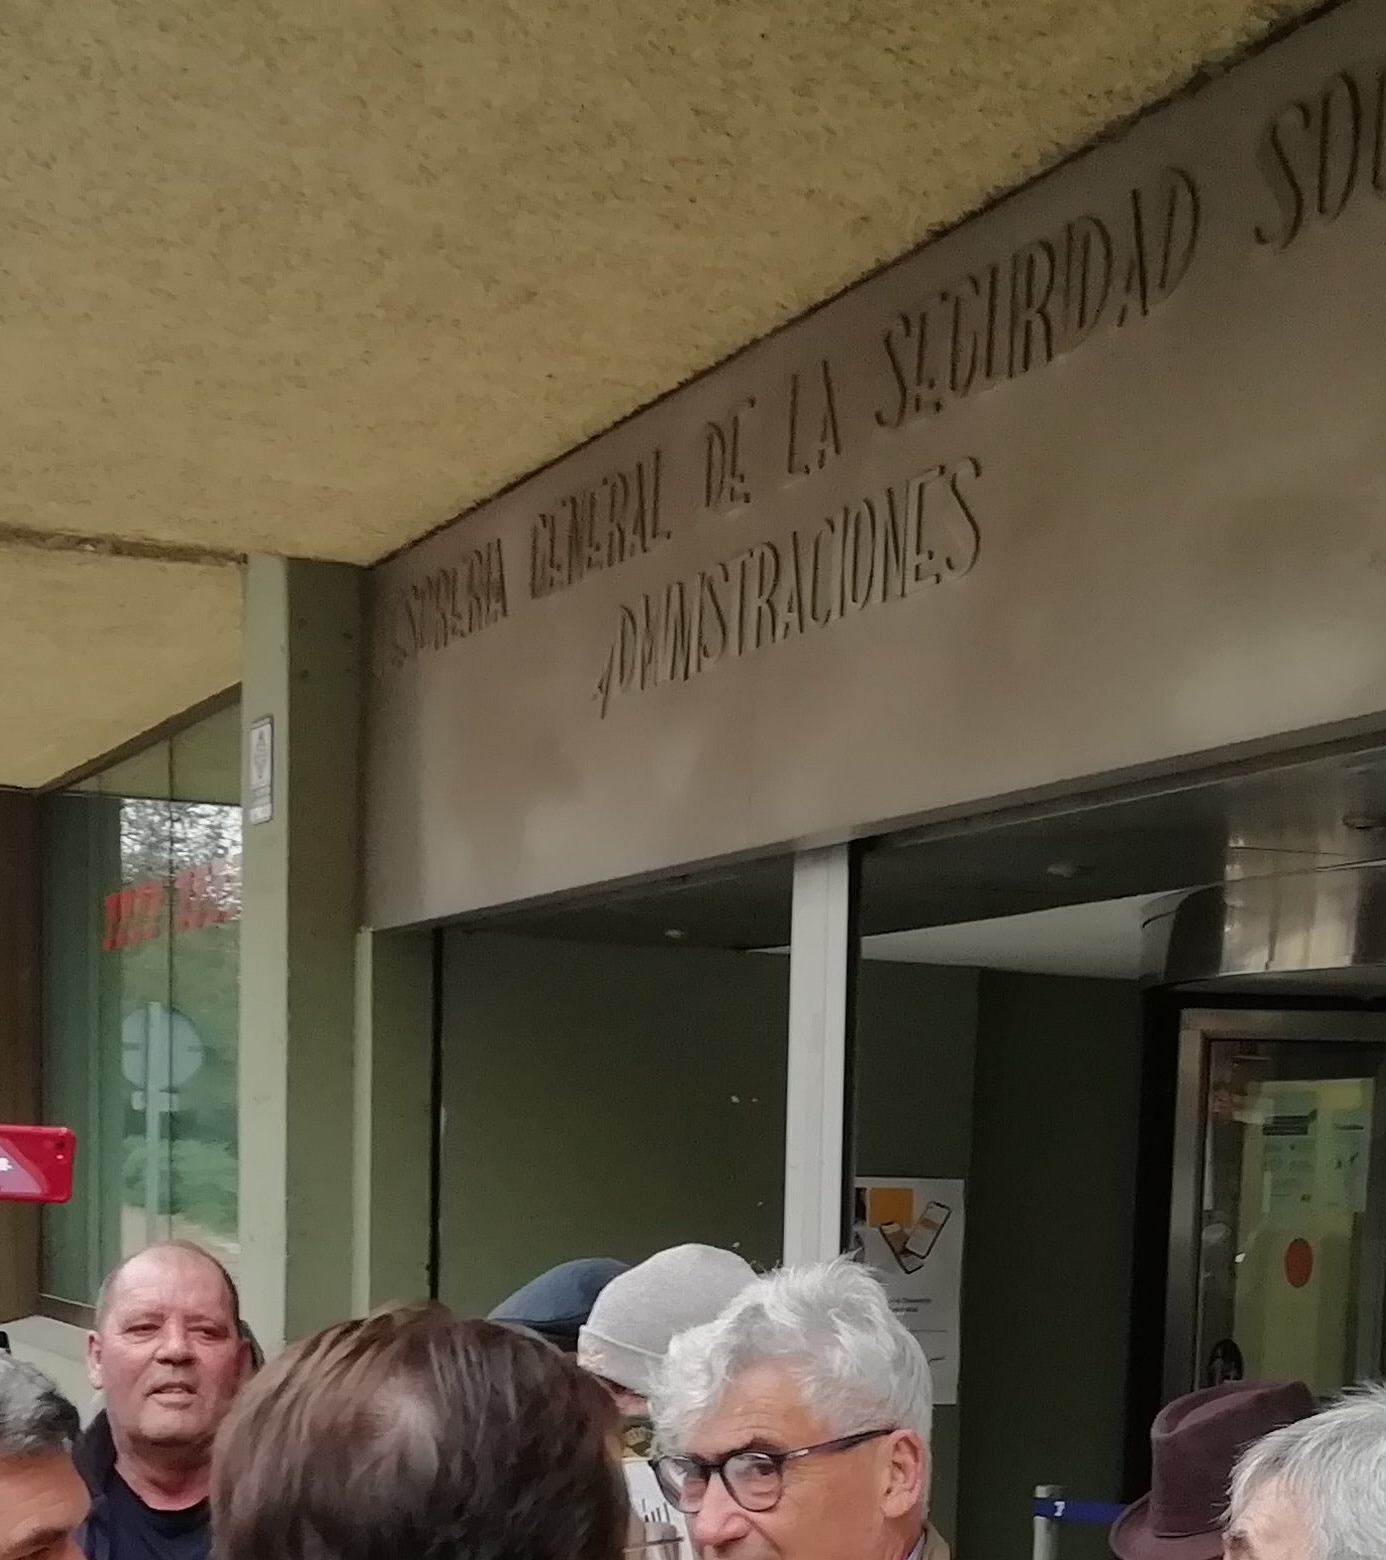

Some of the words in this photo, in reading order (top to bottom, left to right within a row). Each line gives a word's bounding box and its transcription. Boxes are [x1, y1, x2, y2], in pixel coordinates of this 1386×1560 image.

[530, 448, 671, 598] GENERAL
[703, 397, 757, 508] DE
[787, 360, 842, 475] LA
